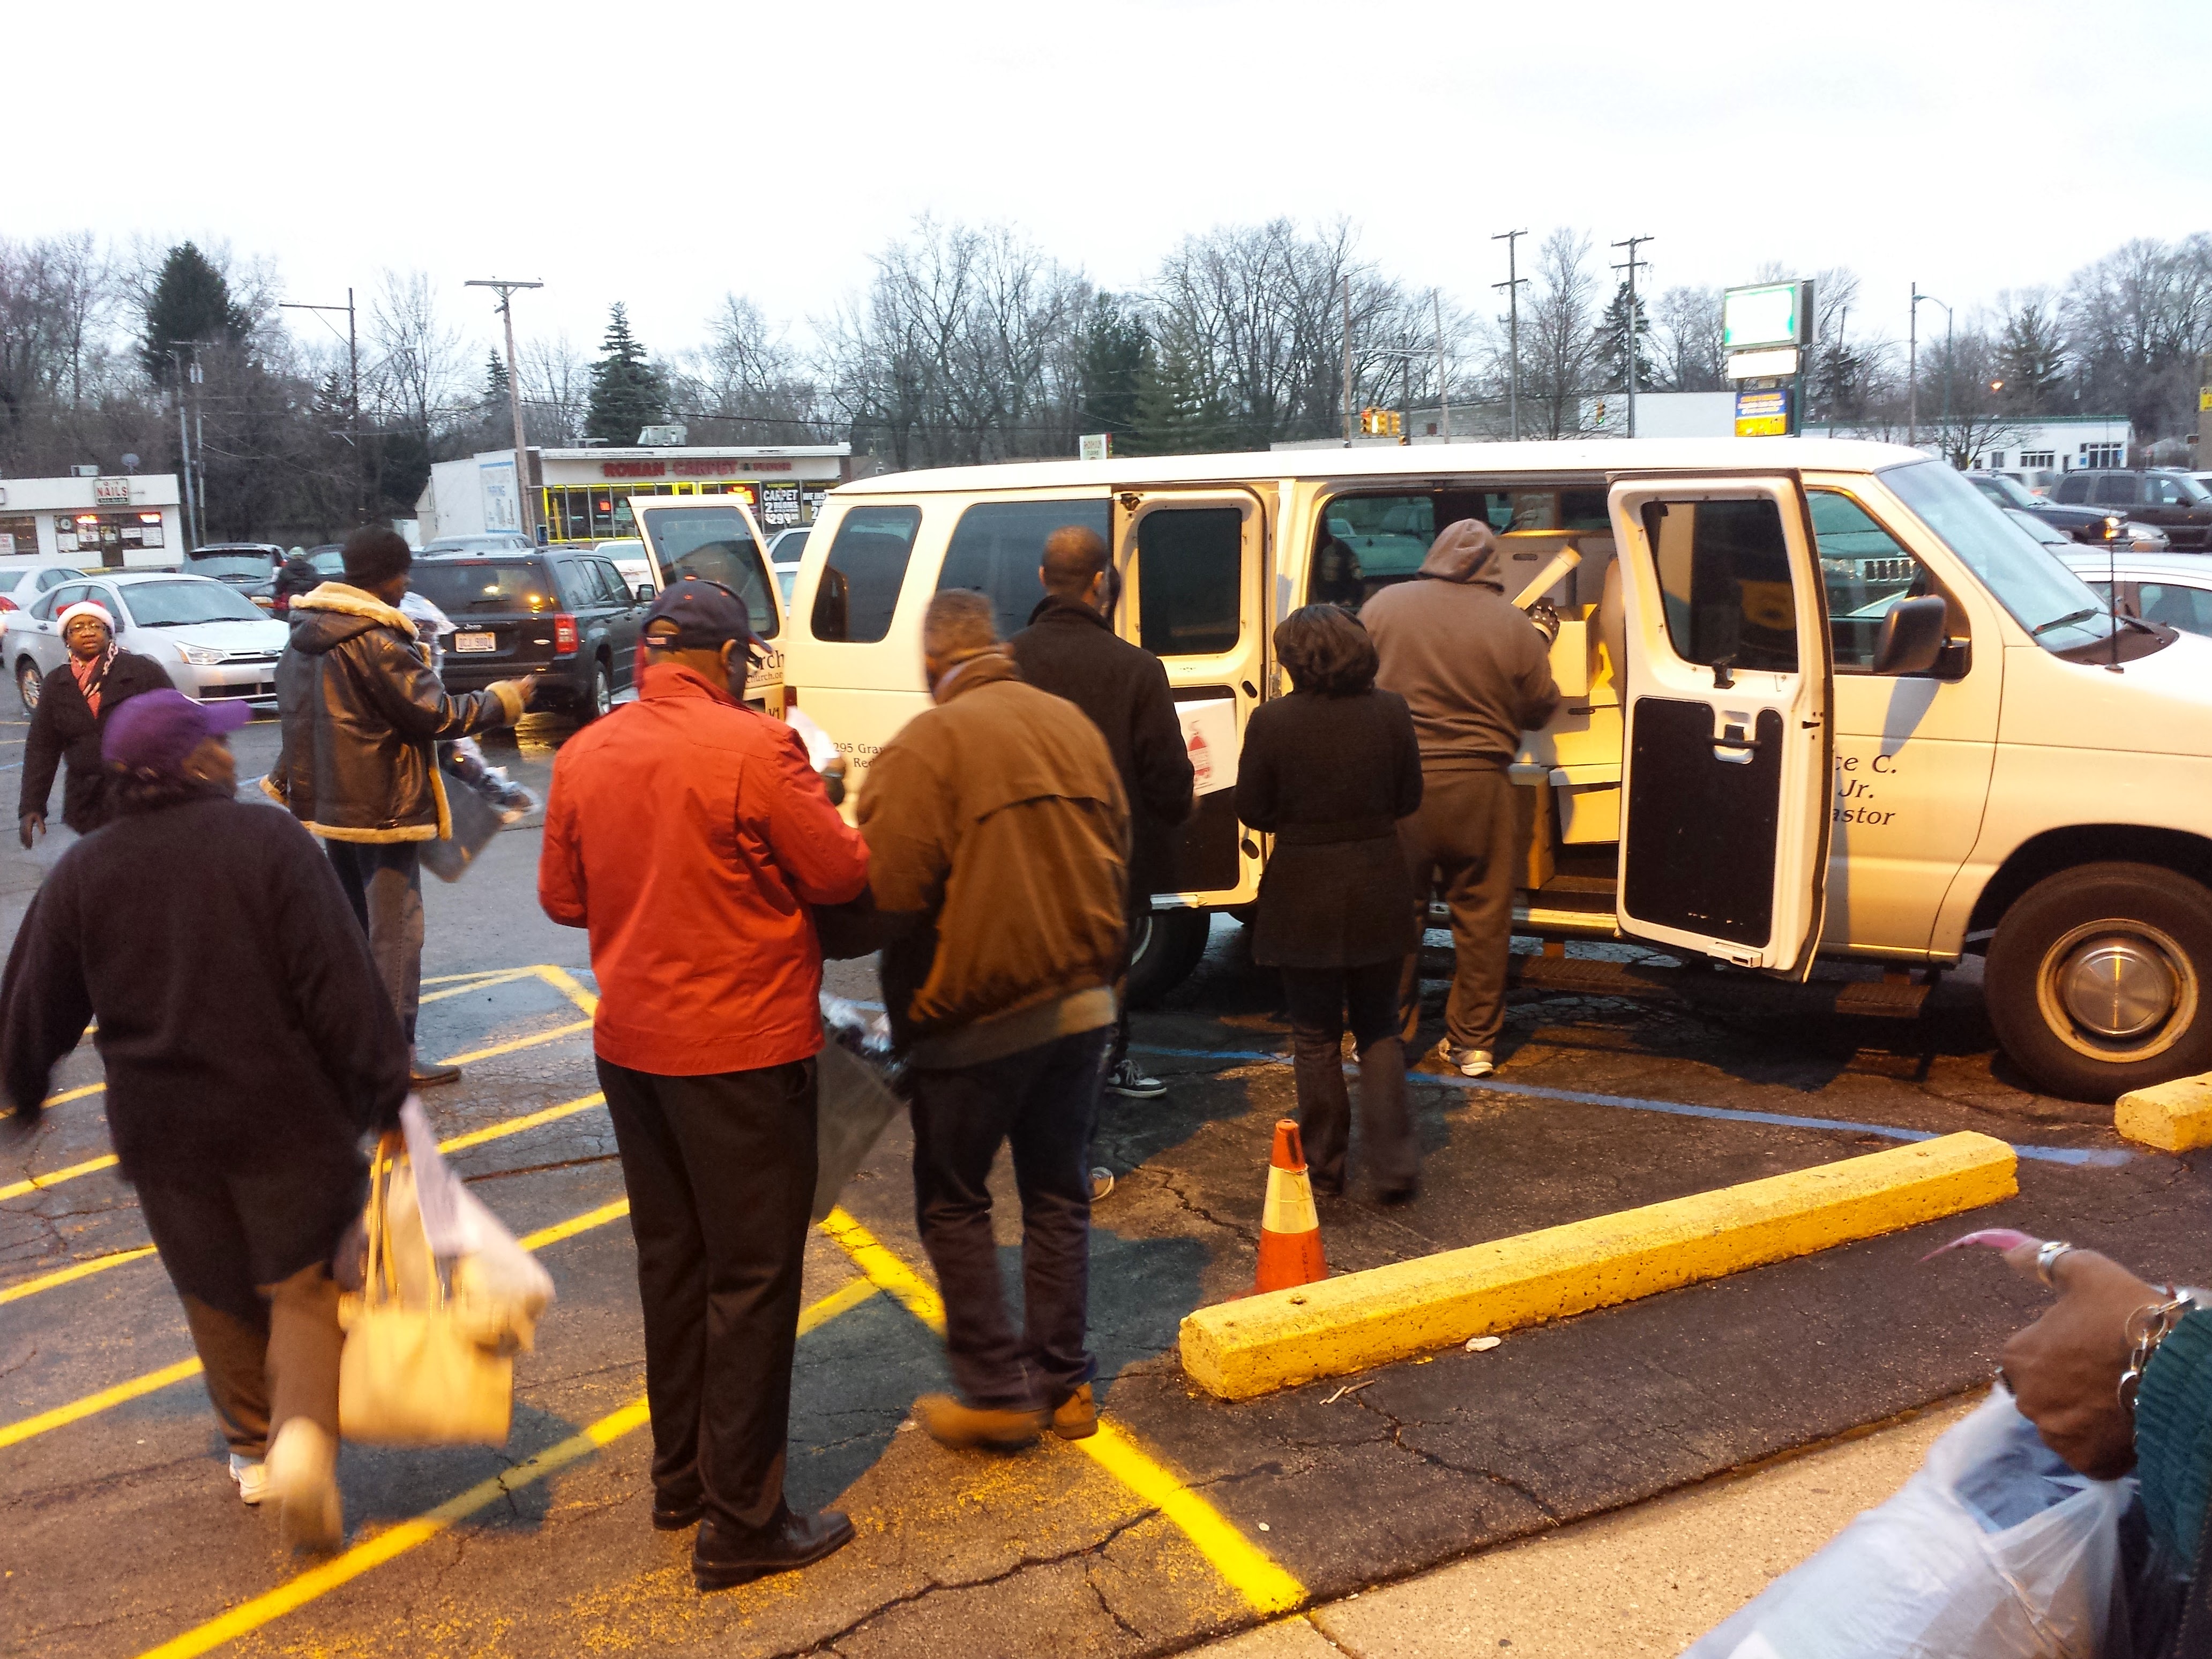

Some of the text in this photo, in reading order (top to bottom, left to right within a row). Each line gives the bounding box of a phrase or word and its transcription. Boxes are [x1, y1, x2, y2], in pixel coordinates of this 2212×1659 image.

[603, 462, 665, 476] ROMAN
[673, 461, 738, 475] CARPET
[97, 487, 127, 497] NAILS
[763, 489, 798, 501] CARPET
[765, 502, 773, 513] 2
[1871, 754, 1897, 773] C.
[1838, 780, 1873, 798] Jr.
